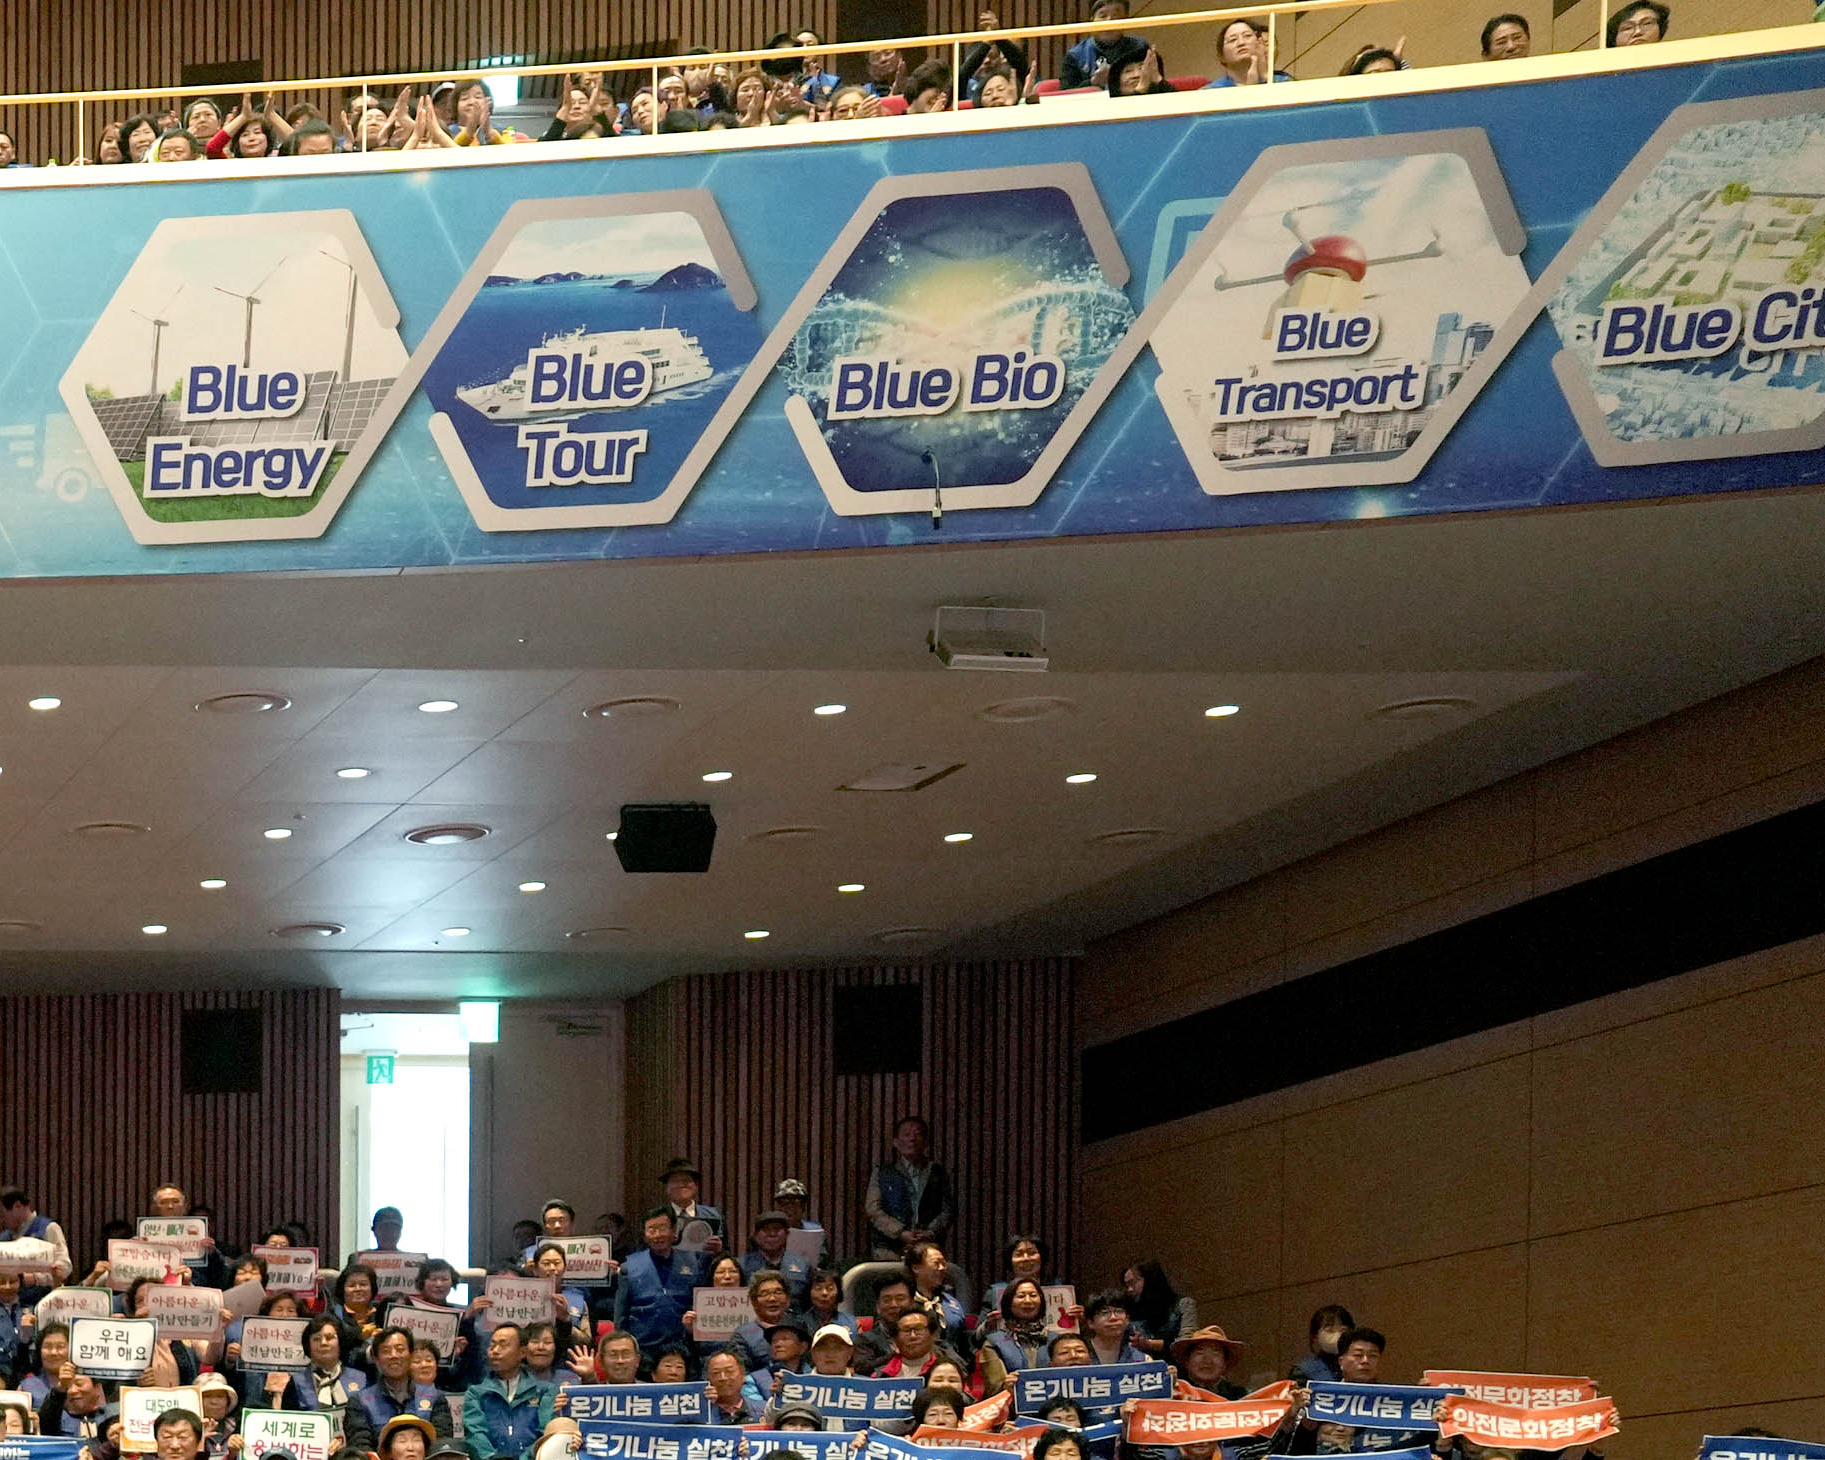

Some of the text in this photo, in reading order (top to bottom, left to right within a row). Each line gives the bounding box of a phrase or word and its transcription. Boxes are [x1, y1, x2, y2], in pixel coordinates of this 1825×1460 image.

[1279, 314, 1371, 352] Blue
[1603, 287, 1825, 357] Blue Cit
[187, 367, 300, 414] Blue
[531, 355, 646, 402] Blue
[835, 352, 1059, 410] Blue Bio
[1216, 367, 1418, 417] Transport
[152, 441, 328, 494] Energy
[531, 431, 640, 480] Tour
[78, 1345, 148, 1362] 함께 해요
[100, 1328, 129, 1344] 우리
[570, 1393, 700, 1418] 온기나눔 실천
[261, 1420, 316, 1440] 세계로
[585, 1433, 679, 1460] 온기나눔
